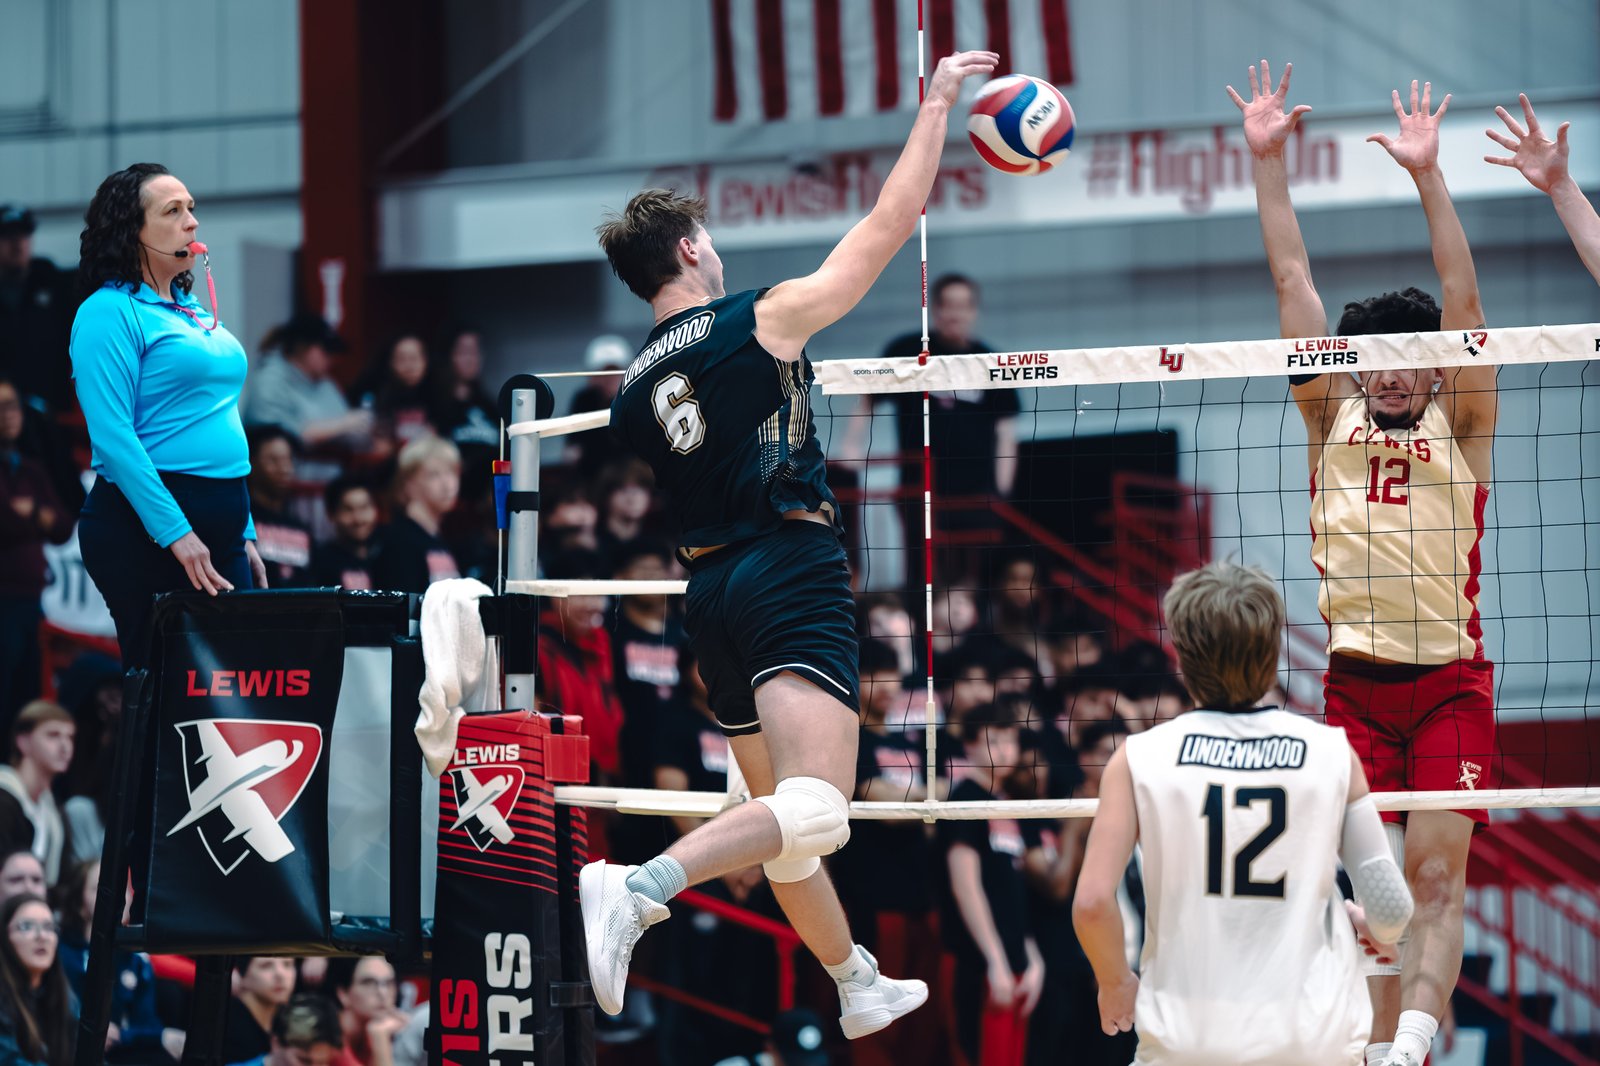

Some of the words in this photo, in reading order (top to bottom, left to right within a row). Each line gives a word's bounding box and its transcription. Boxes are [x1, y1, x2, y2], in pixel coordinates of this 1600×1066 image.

[623, 314, 711, 387] LINDENWOOD
[997, 353, 1049, 367] LEWIS
[1159, 346, 1185, 373] LU
[1287, 351, 1358, 367] FLYERS
[1295, 338, 1348, 353] LEWIS
[989, 366, 1058, 381] FLYERS
[651, 371, 706, 455] 6
[1366, 455, 1411, 506] 12
[186, 669, 311, 697] LEWIS
[453, 743, 520, 766] LEWIS
[1179, 734, 1306, 770] LINDENWOOD
[1199, 782, 1288, 901] 12
[484, 932, 535, 1066] RS
[440, 978, 480, 1066] IS
